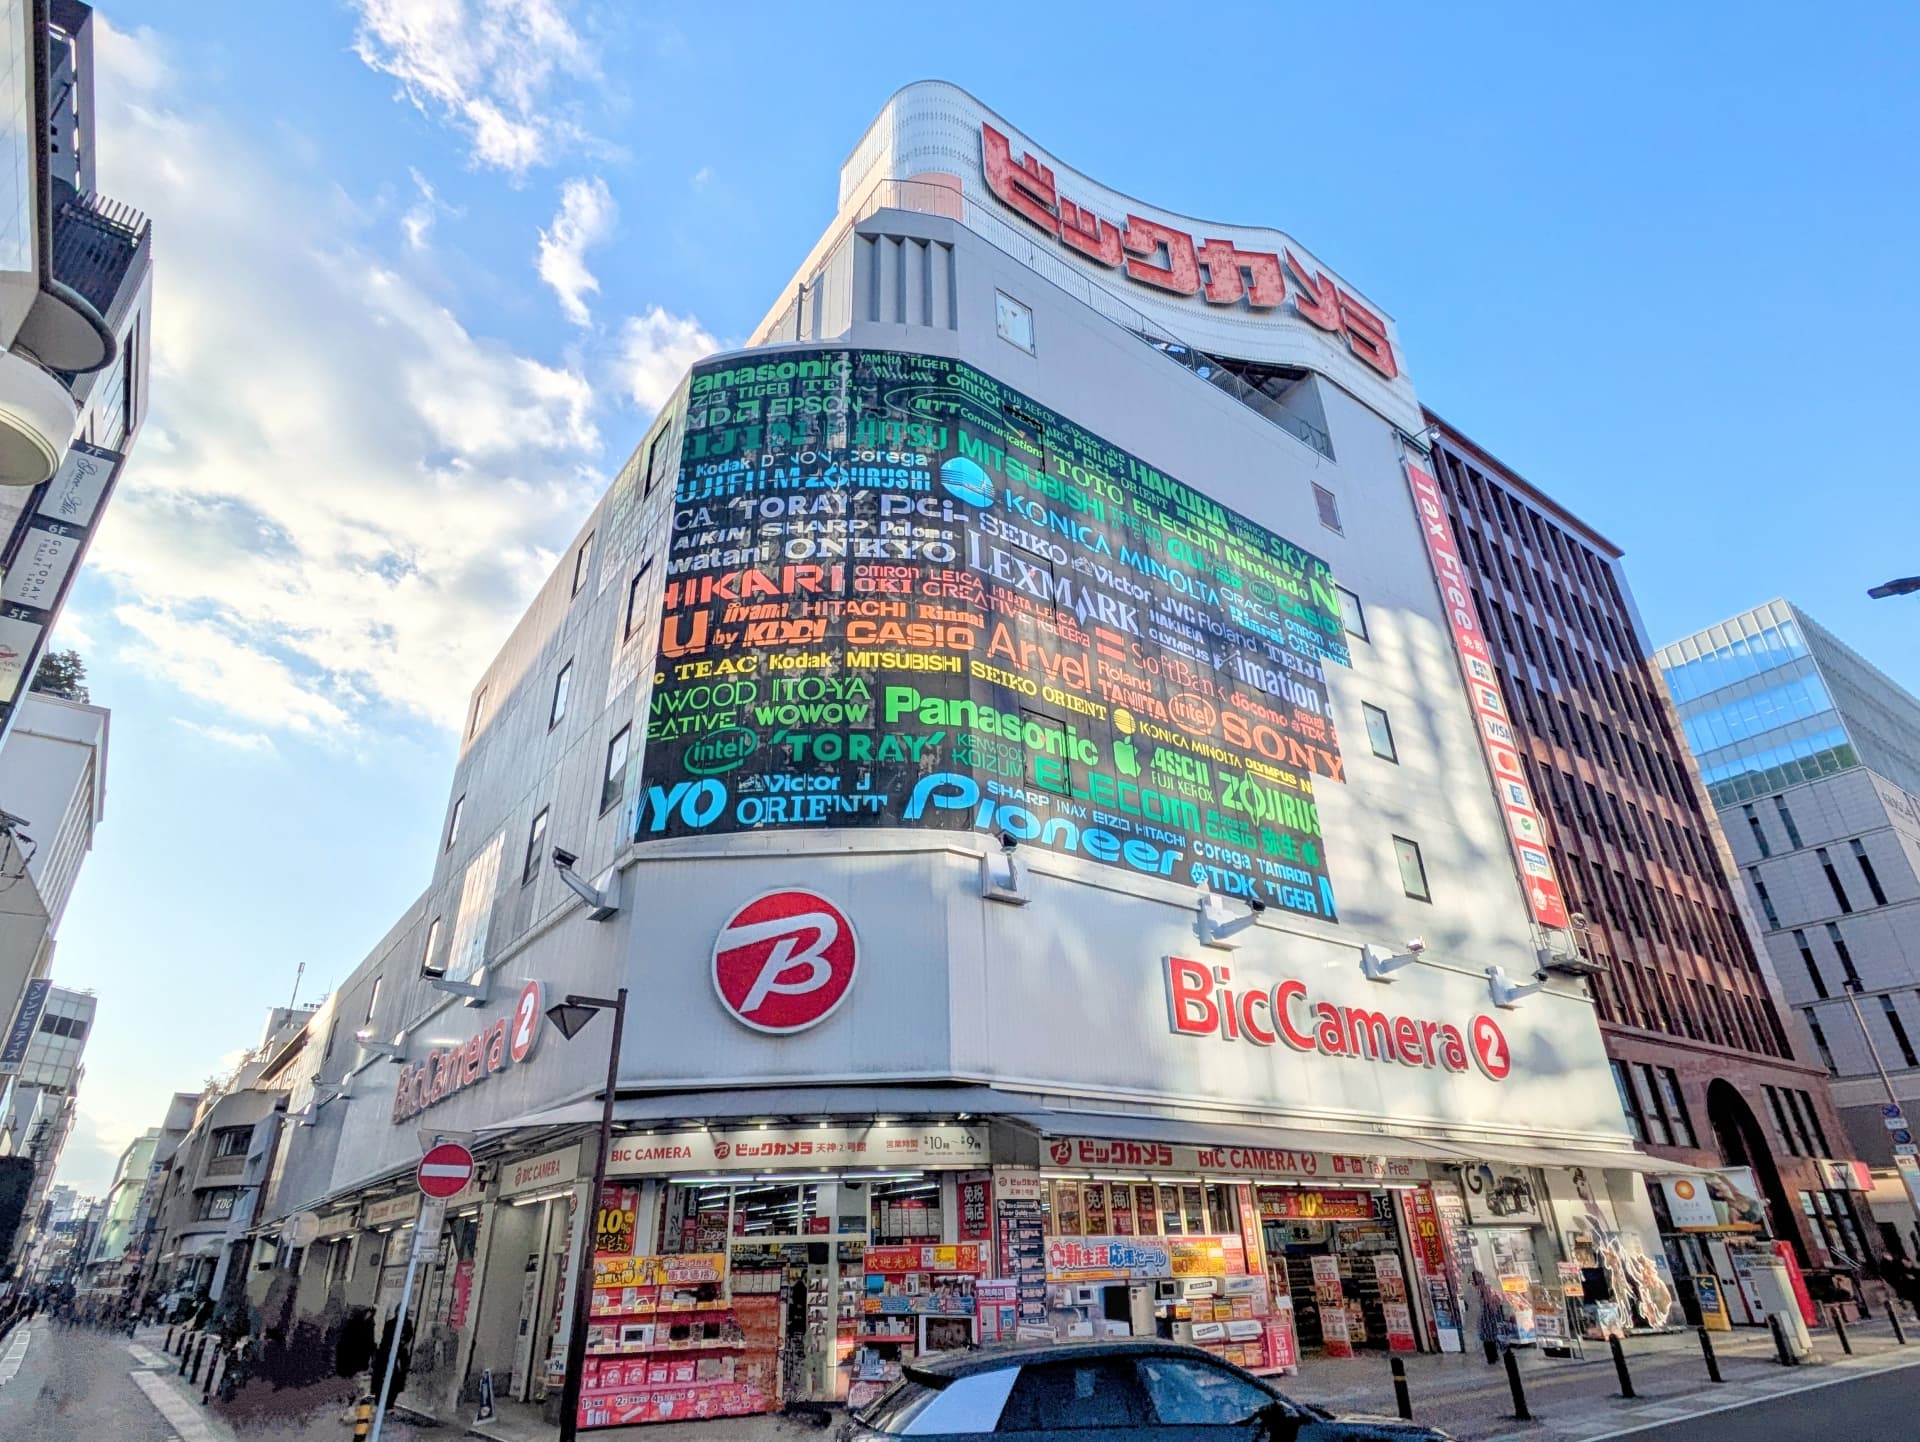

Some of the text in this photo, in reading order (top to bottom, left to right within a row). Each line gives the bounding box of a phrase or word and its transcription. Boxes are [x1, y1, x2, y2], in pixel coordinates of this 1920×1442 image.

[981, 121, 1398, 379] ビックカメラ
[691, 355, 852, 393] anasonic
[910, 358, 949, 371] TIGER
[956, 364, 999, 394] PENTAX
[738, 382, 789, 399] TIGER
[960, 407, 1044, 458] Communications
[695, 456, 751, 478] Kodak
[1074, 438, 1125, 474] PHILIPS
[957, 429, 1106, 523] MITSUBISHI
[1052, 454, 1124, 505] TOTO
[1129, 458, 1229, 530] HAKUBA
[727, 490, 869, 518] TORAY
[48, 524, 69, 535] 6F
[761, 520, 869, 537] SHARP
[978, 512, 1068, 564] SEIKO
[1132, 498, 1218, 556] ELECOM
[783, 538, 957, 562] ONKYO
[1004, 489, 1111, 555] KONICA
[1119, 545, 1219, 606] MINOLTA
[1270, 536, 1308, 569] SKY
[1415, 479, 1473, 631] Tax Free
[30, 539, 62, 600] GO TODAY
[854, 579, 912, 594] OKI
[930, 568, 984, 591] LEICA
[968, 528, 1143, 638] LEXMARK
[1225, 545, 1309, 600] Nintendo
[8, 607, 31, 620] 5F
[803, 600, 906, 619] HITACHI
[922, 581, 1030, 625] CREATIVE
[1093, 566, 1152, 604] Victor
[1160, 597, 1196, 624] JVC
[1220, 587, 1281, 625] ORACLE
[919, 604, 985, 628] Rinnai
[1278, 593, 1340, 636] CASIO
[712, 619, 828, 650] by KDDI
[846, 621, 975, 650] CASIO
[1148, 627, 1210, 661] OLYMPUS
[986, 622, 1092, 694] Arvel
[1098, 660, 1152, 692] Roland
[1131, 642, 1227, 703] SoftBank
[674, 655, 759, 680] TEAC
[769, 653, 833, 670] Kodak
[846, 652, 962, 673] MITSUBISHI
[970, 659, 1037, 696] SEIKO
[1041, 686, 1107, 720] ORIENT
[1097, 678, 1169, 723] TANITA
[753, 704, 869, 726] WOWOW
[884, 686, 1099, 766] Panasonic
[1487, 720, 1511, 741] VISA
[769, 731, 946, 763] TORAY
[957, 732, 1027, 764] KENWOOD
[1139, 720, 1190, 750] KONICA
[1191, 740, 1242, 768] MINOLTA
[1244, 757, 1297, 785] OLYMPUS
[1220, 709, 1347, 784] SONY
[761, 765, 841, 793] Victor
[1150, 747, 1210, 787] ASCII
[647, 778, 727, 830] YO
[1034, 755, 1200, 833] ELECOM
[1151, 770, 1215, 804] FUJI XEROX
[903, 772, 1184, 876] Pioneer
[987, 779, 1186, 848] SHARP INAX EIZO HITACHI
[1205, 821, 1258, 850] CASIO
[1192, 839, 1313, 887] corega TAMRON
[1204, 863, 1318, 914] TDK TIGER
[6, 981, 46, 1059] マシンピラティス
[1166, 955, 1469, 1074] BicCamera
[393, 1018, 510, 1124] BicCamera
[610, 1146, 692, 1162] BIC CAMERA
[735, 1141, 813, 1157] ビックカメラ
[1078, 1140, 1173, 1166] ビックカメラ
[1198, 1150, 1226, 1168] BIC
[1230, 1149, 1298, 1171] CAMERA
[1367, 1161, 1386, 1175] Tax
[1387, 1162, 1410, 1176] Free
[964, 1184, 984, 1202] 免税
[964, 1203, 985, 1221] 商店
[867, 1255, 918, 1270] 欢迎光临
